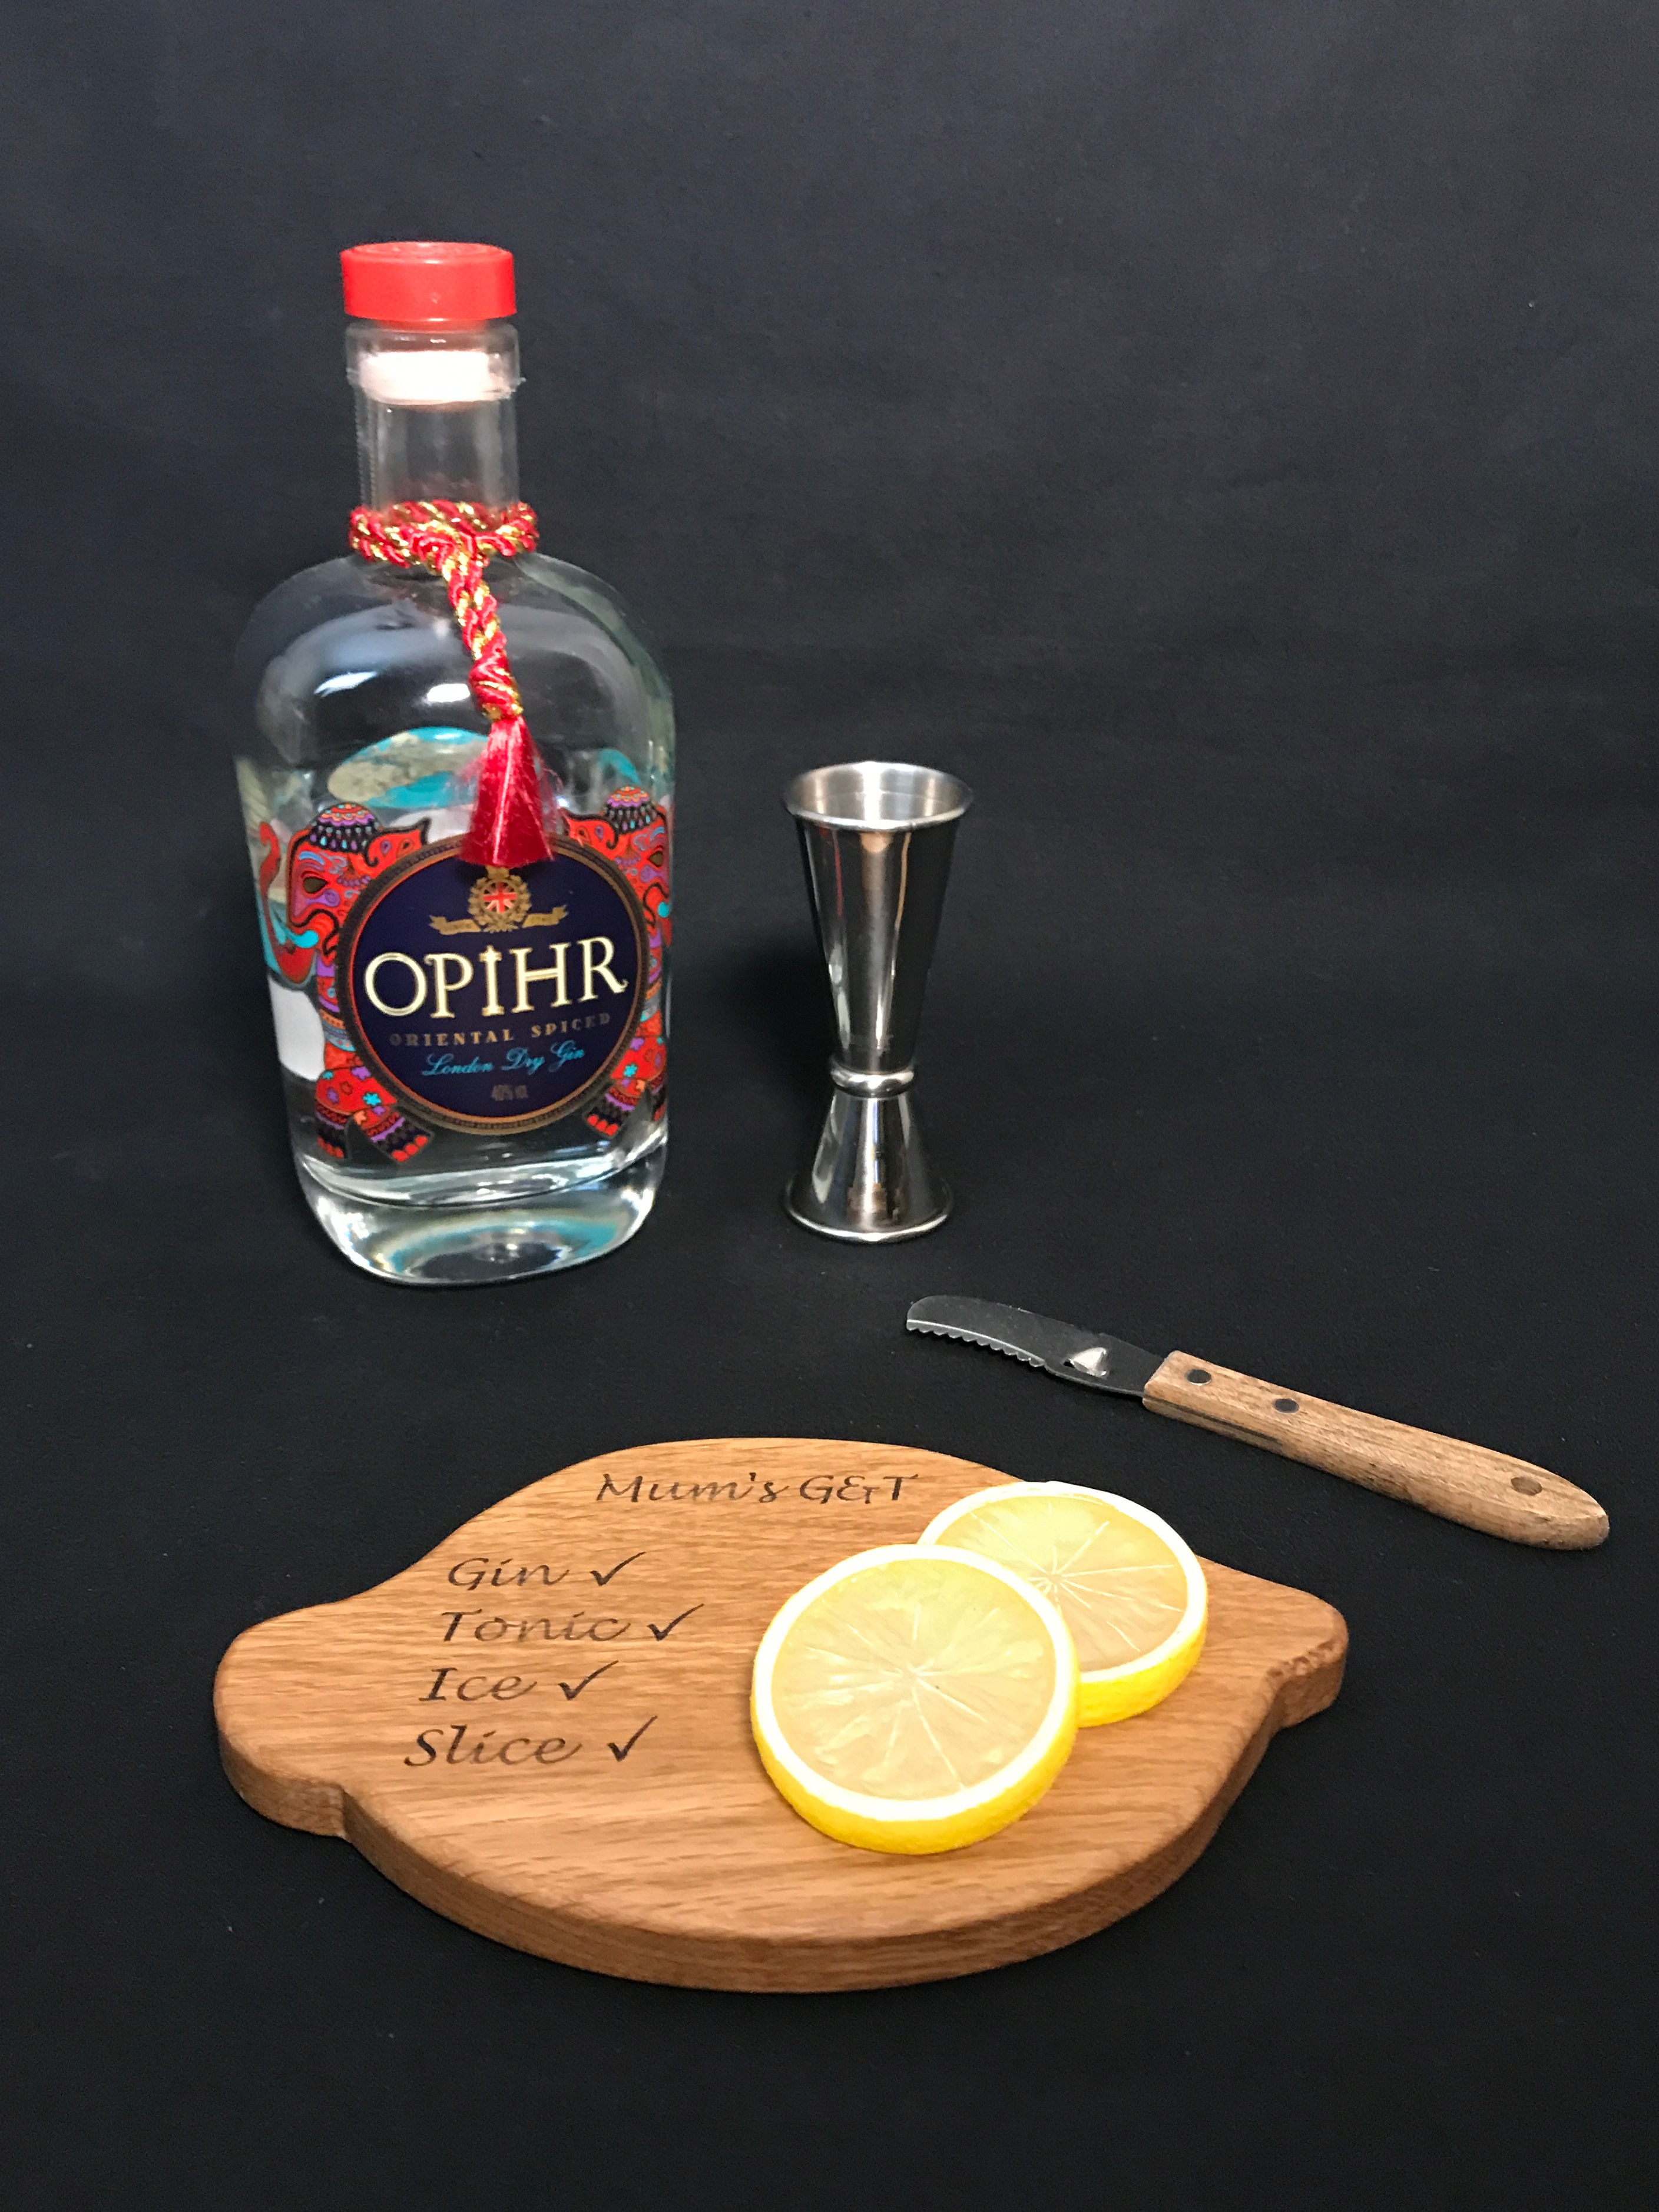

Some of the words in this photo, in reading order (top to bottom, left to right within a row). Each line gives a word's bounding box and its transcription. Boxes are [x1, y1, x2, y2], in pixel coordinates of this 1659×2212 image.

[364, 936, 628, 1019] OPIHR
[389, 1029, 514, 1047] ORIENTAL
[531, 1012, 611, 1038] SPICED
[422, 1053, 493, 1076] London
[501, 1047, 545, 1074] Dry
[548, 1039, 585, 1072] Gin
[596, 1472, 788, 1504] Mum's
[799, 1473, 919, 1504] G&T
[448, 1557, 569, 1591] Gin
[441, 1609, 631, 1643] Tonic
[419, 1667, 537, 1701] Ice
[404, 1725, 582, 1767] Slice
